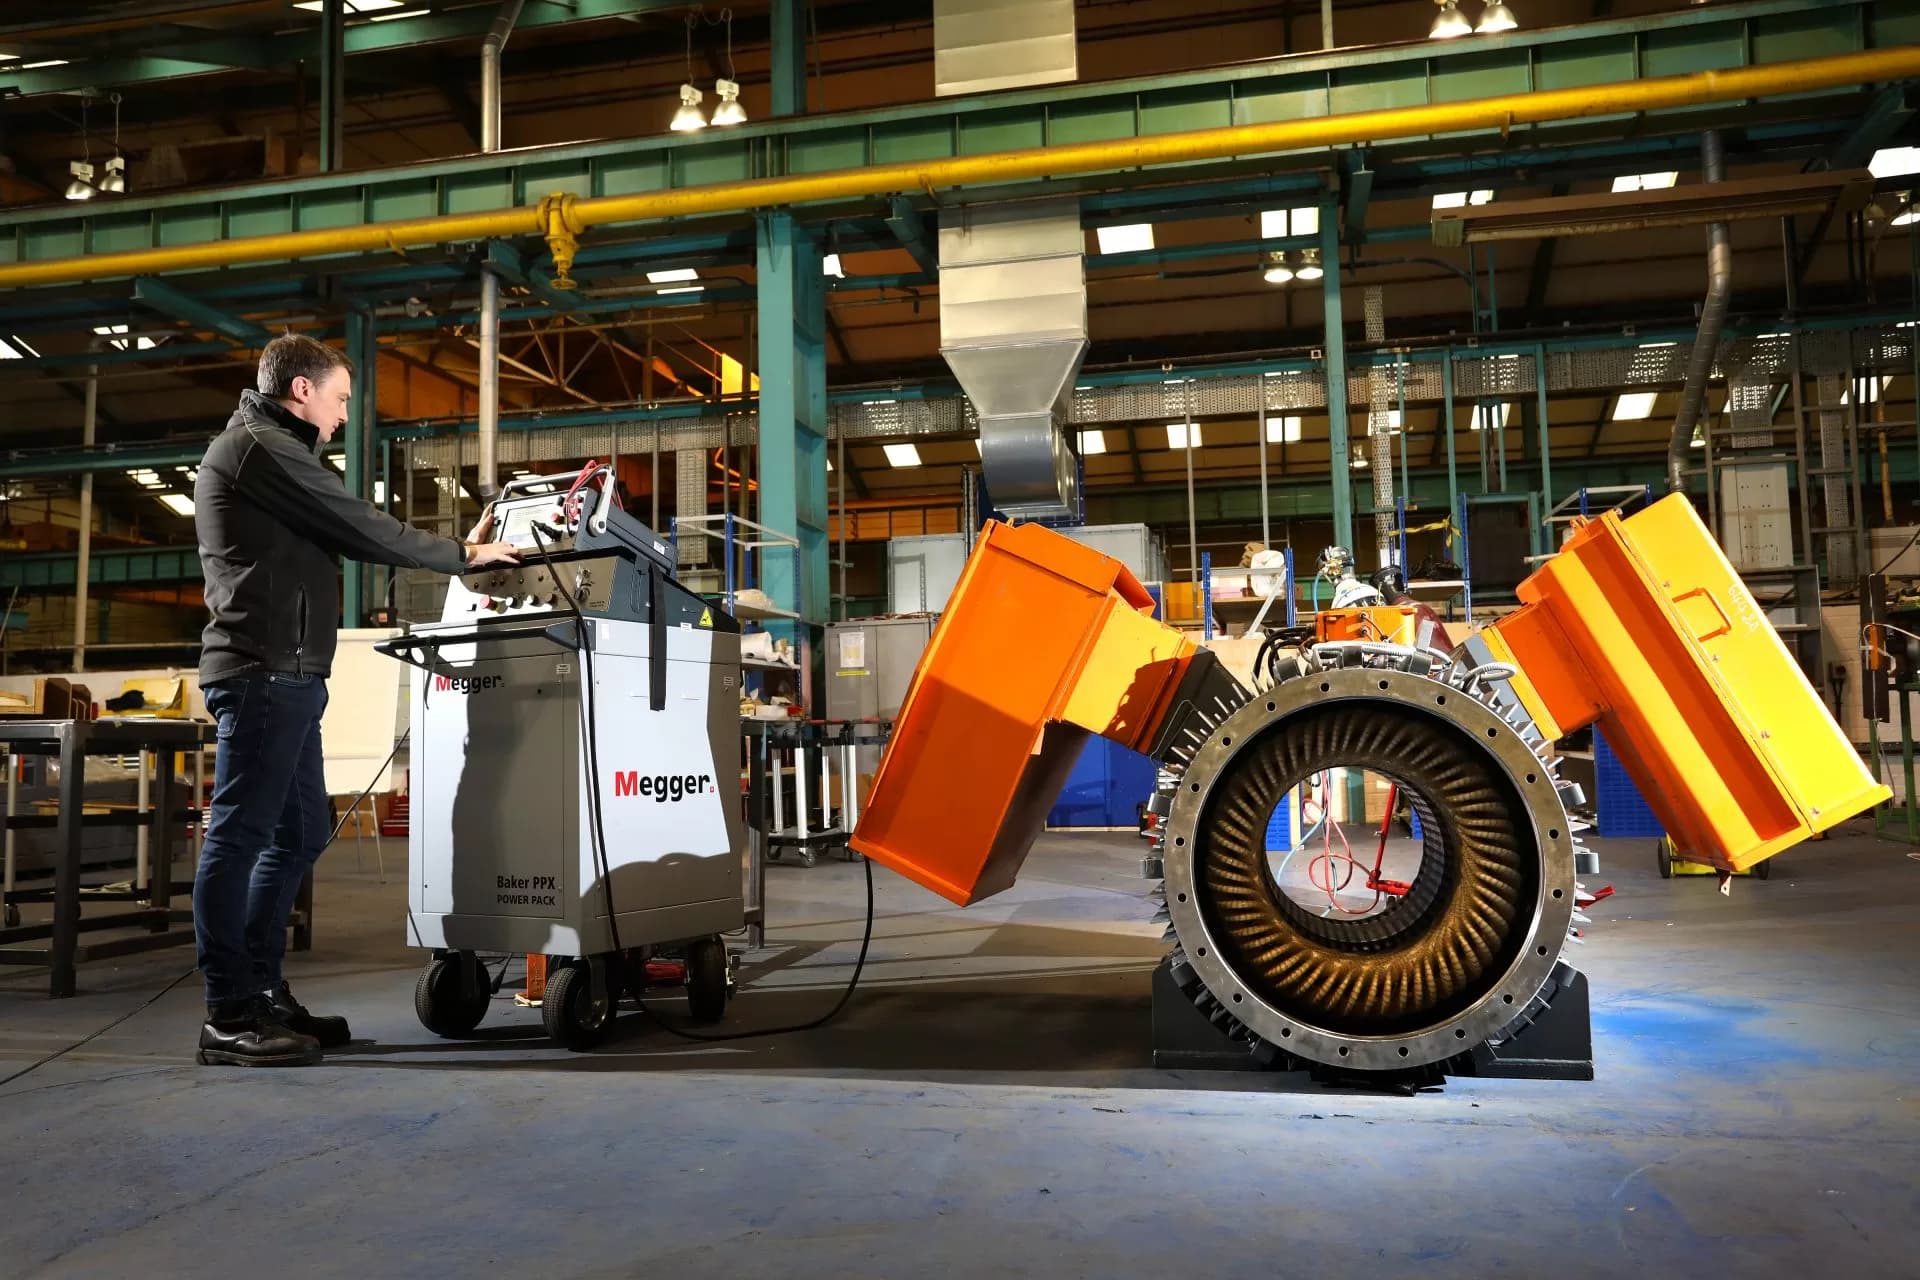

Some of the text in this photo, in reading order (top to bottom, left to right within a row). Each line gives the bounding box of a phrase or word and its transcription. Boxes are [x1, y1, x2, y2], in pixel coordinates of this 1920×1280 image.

[497, 875, 556, 890] Baker PPX
[497, 894, 556, 906] POWER PACK
